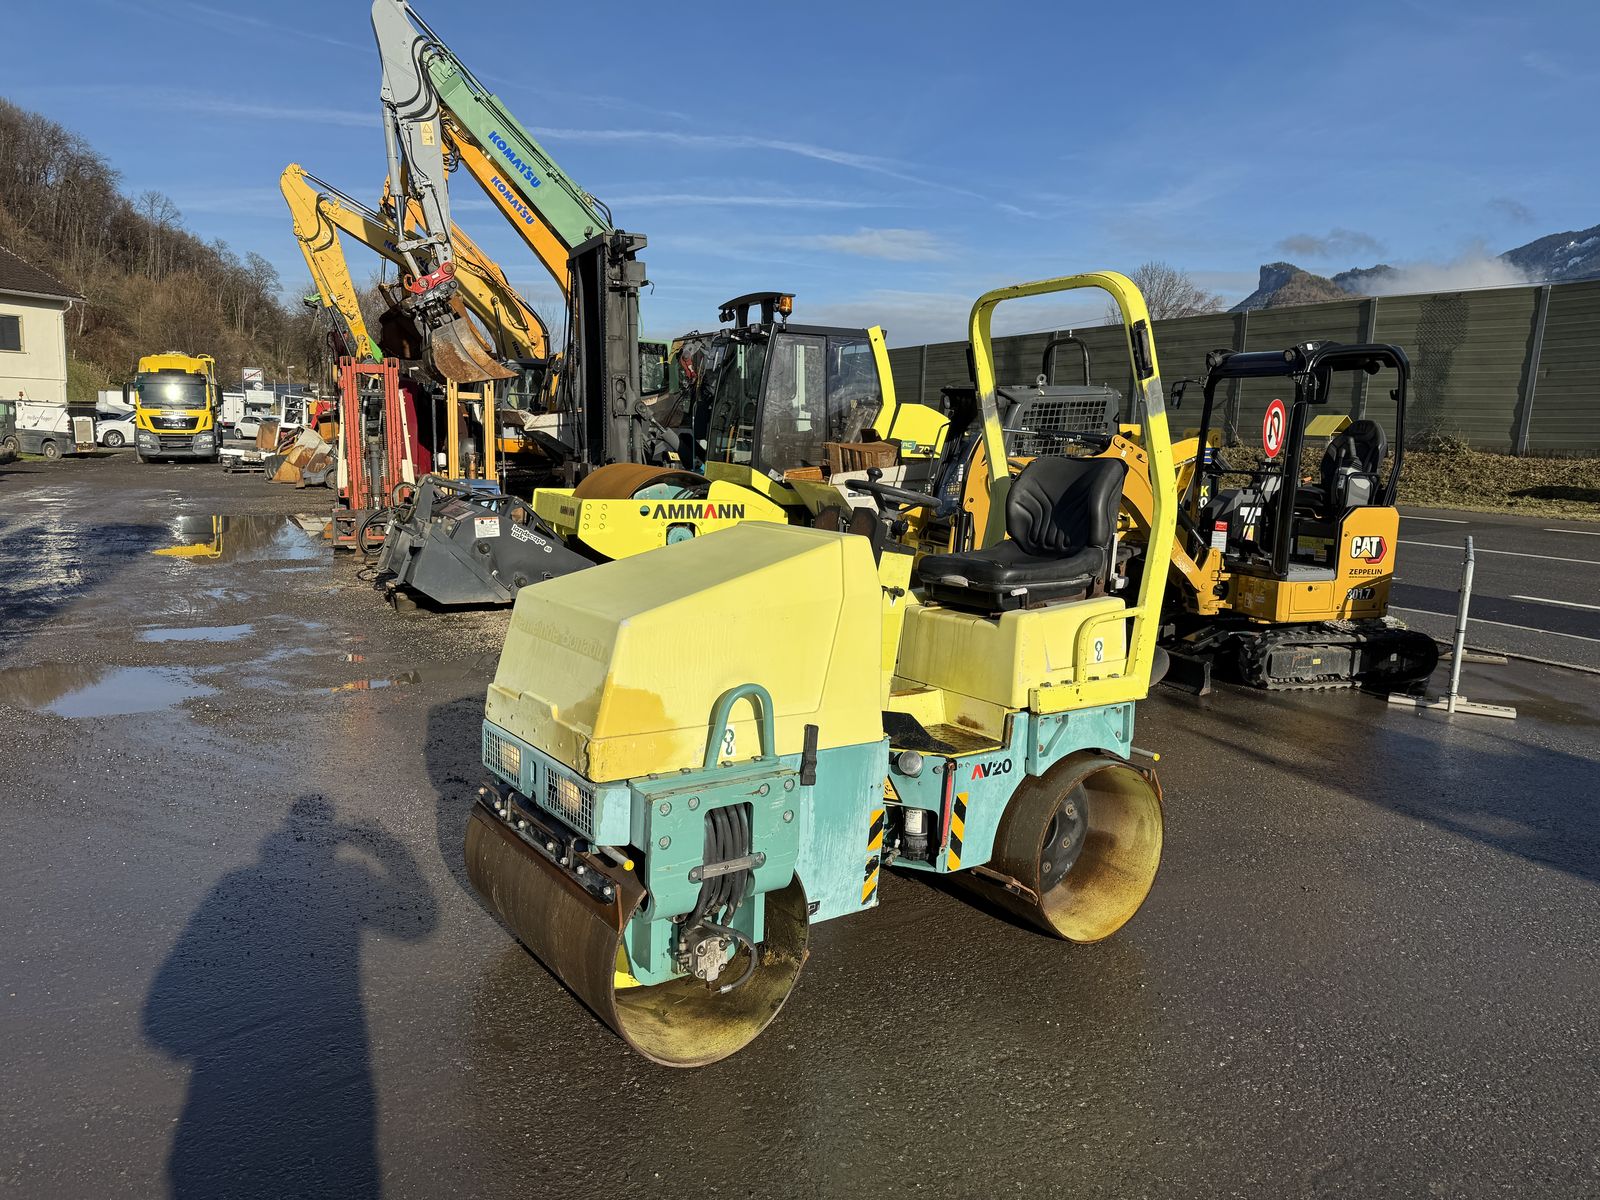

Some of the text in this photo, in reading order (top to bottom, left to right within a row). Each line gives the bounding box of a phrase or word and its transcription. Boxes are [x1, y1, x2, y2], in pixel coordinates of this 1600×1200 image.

[487, 130, 541, 188] KOMATSU
[491, 175, 535, 225] KOMATSU
[652, 504, 745, 519] AMMANN
[511, 524, 546, 545] landscape
[1351, 536, 1380, 558] CAT
[1347, 588, 1371, 600] 301.7
[971, 758, 1012, 780] AV20
